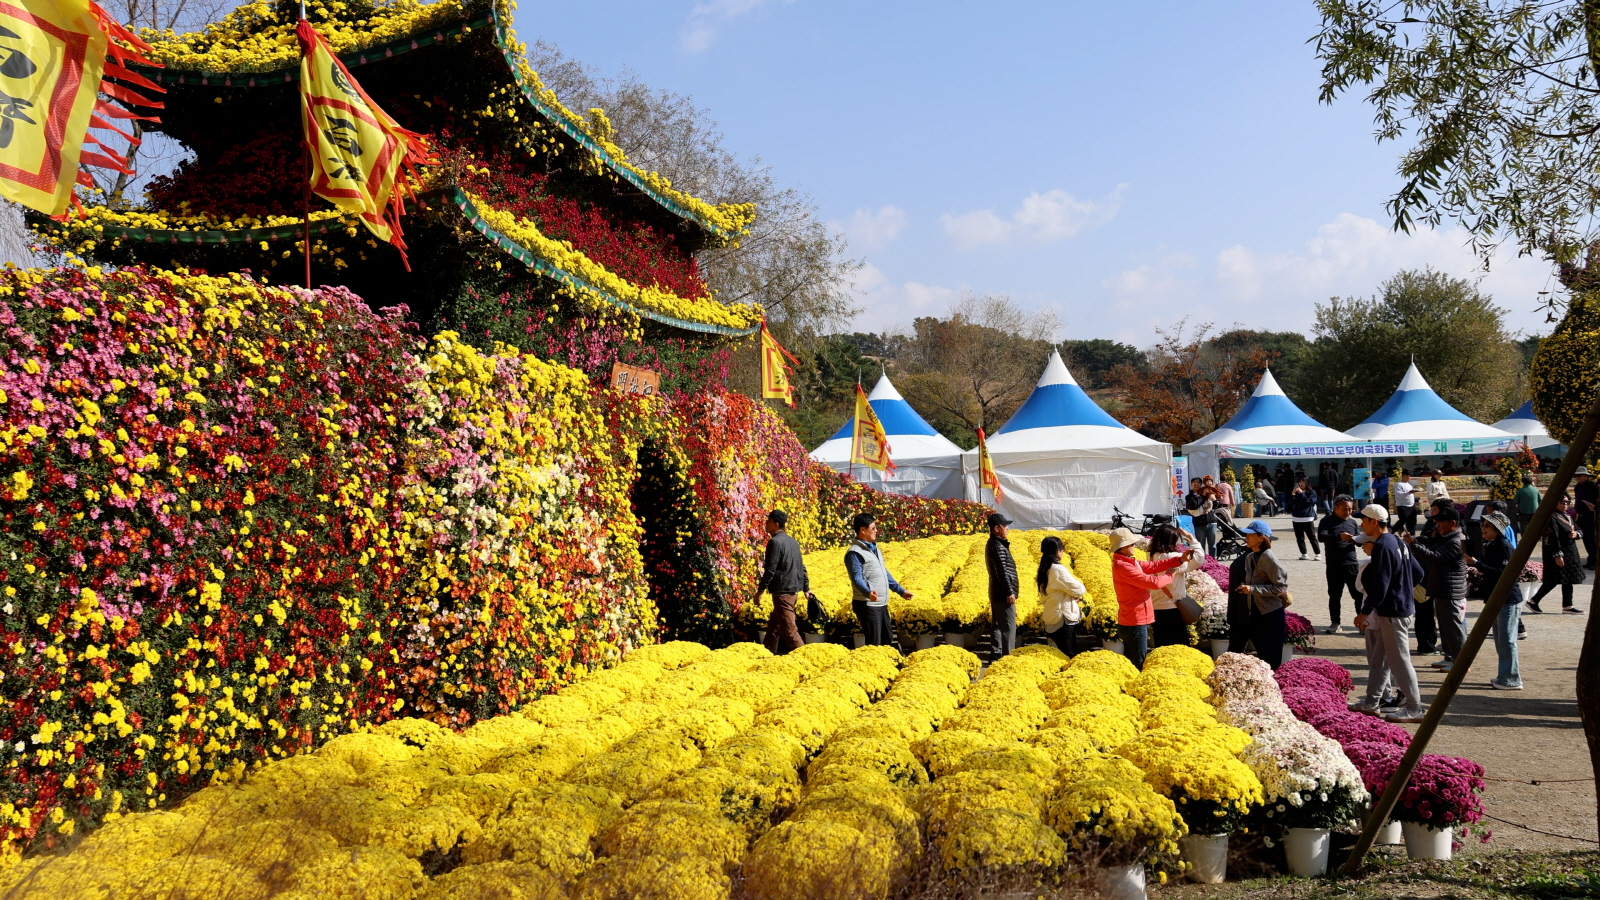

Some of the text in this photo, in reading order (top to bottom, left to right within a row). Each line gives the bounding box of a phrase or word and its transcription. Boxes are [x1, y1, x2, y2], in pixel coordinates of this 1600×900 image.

[1266, 447, 1301, 456] 제22회
[1304, 444, 1405, 456] 백제고도부여국화축제
[1175, 468, 1183, 489] 화장실
